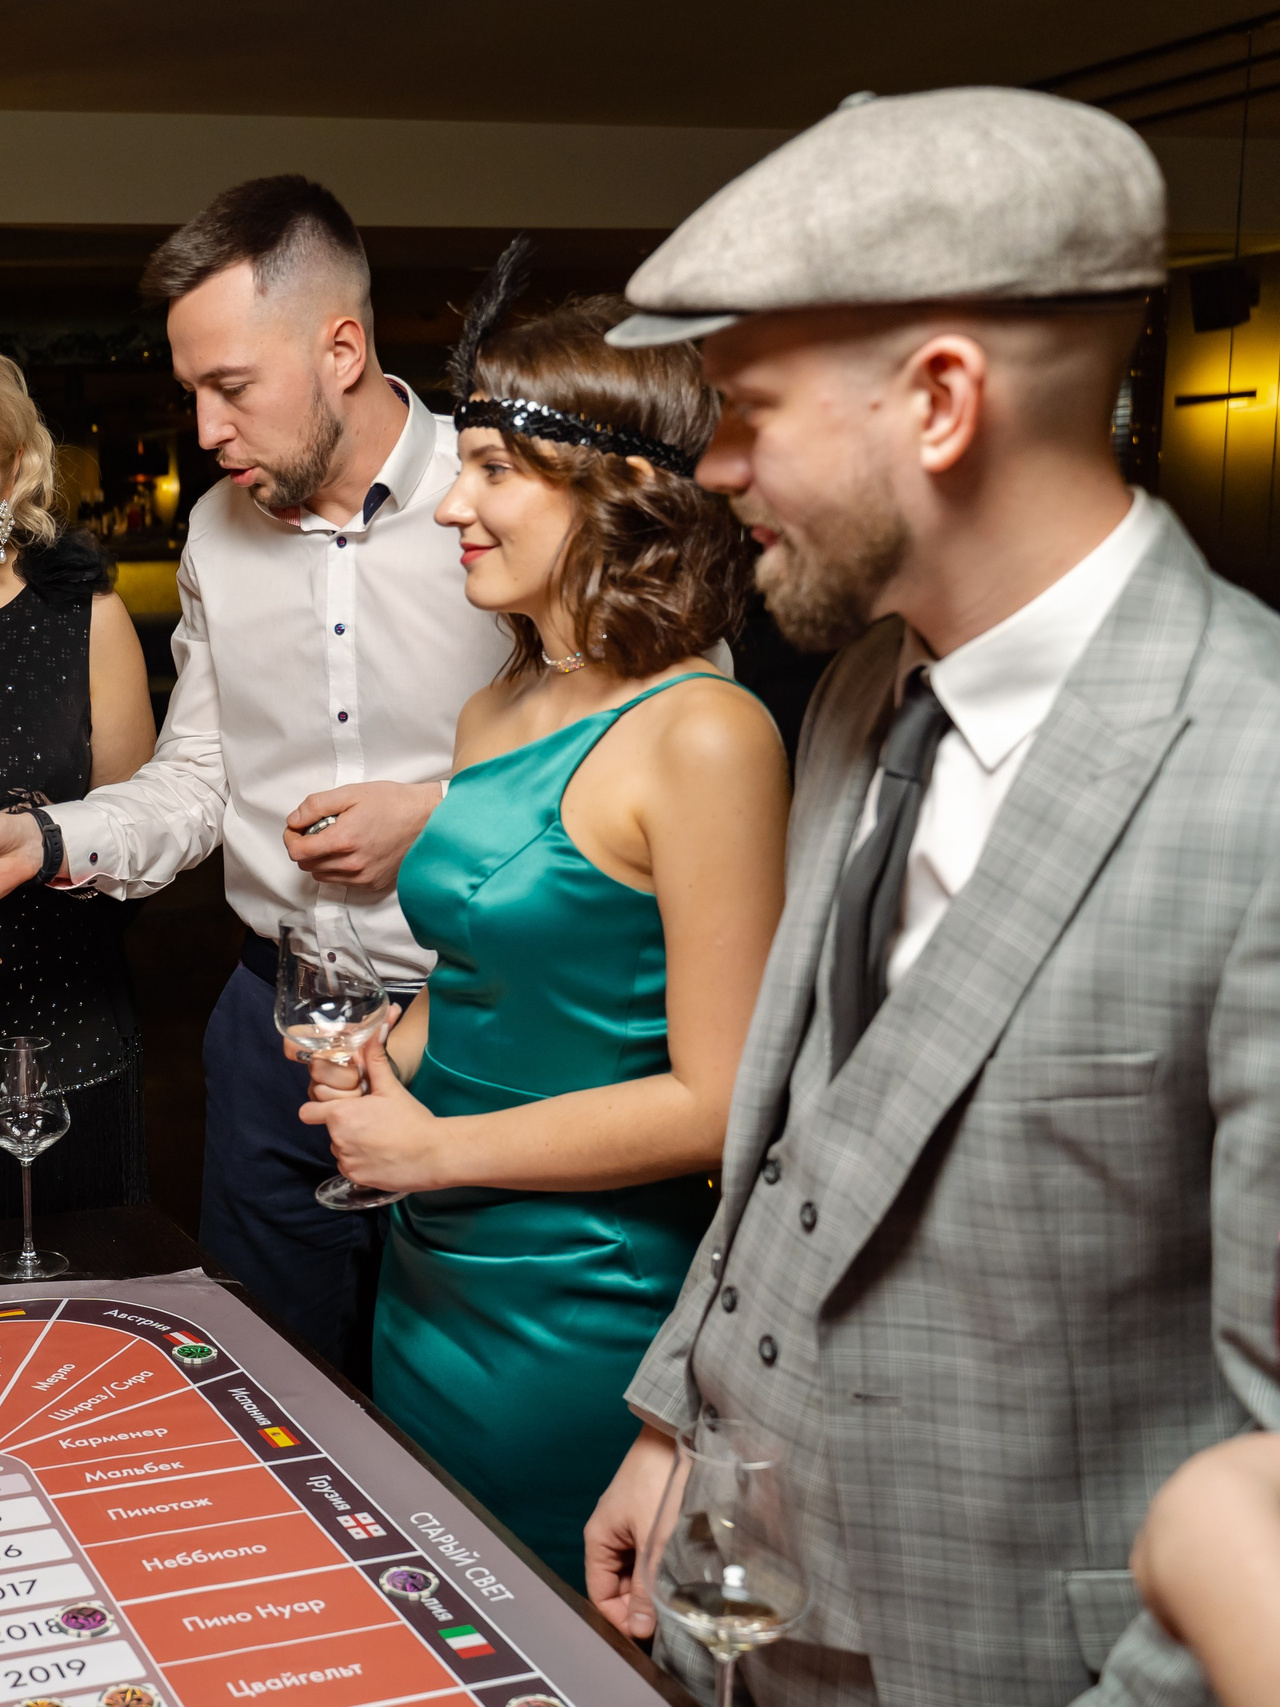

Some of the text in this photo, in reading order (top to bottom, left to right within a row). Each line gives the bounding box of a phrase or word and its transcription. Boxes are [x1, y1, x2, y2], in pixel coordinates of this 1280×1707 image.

[103, 1308, 172, 1333] Австрия
[31, 1362, 76, 1392] Мерло
[227, 1387, 272, 1427] Испания
[58, 1426, 170, 1450] Карменер
[84, 1460, 185, 1484] Мальбек
[305, 1474, 352, 1511] Грузия
[106, 1497, 214, 1522] Пинотаж
[140, 1543, 268, 1573] Неббиоло
[409, 1511, 515, 1603] СТАРЫЙ СВЕТ
[181, 1598, 327, 1633] Пино Нуар
[2, 1657, 88, 1689] 2019
[225, 1662, 363, 1699] Цвайгельт
